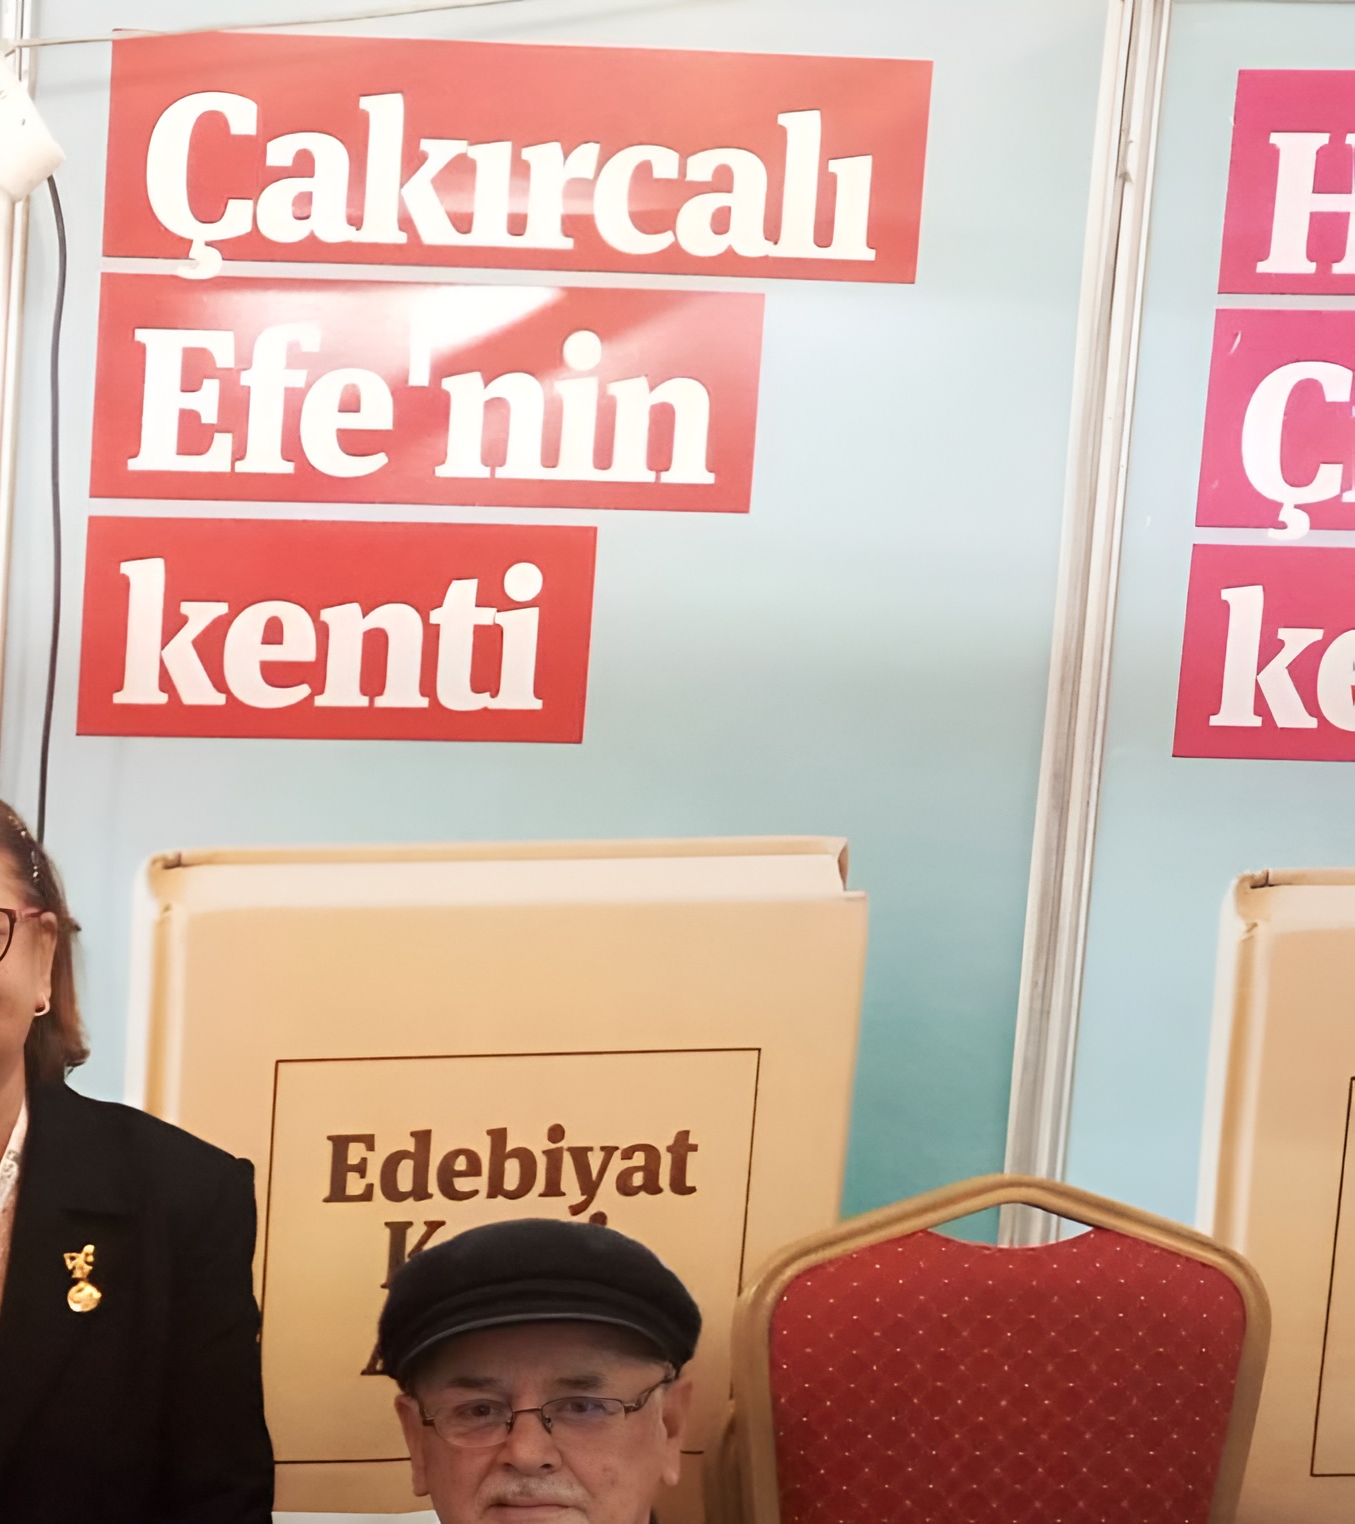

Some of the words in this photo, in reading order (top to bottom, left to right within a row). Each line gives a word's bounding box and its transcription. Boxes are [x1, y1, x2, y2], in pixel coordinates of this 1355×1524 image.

[145, 91, 877, 279] Çakırcalı
[127, 320, 716, 485] Efe'nin
[113, 556, 544, 711] kenti
[322, 1123, 699, 1217] Edebiyat
